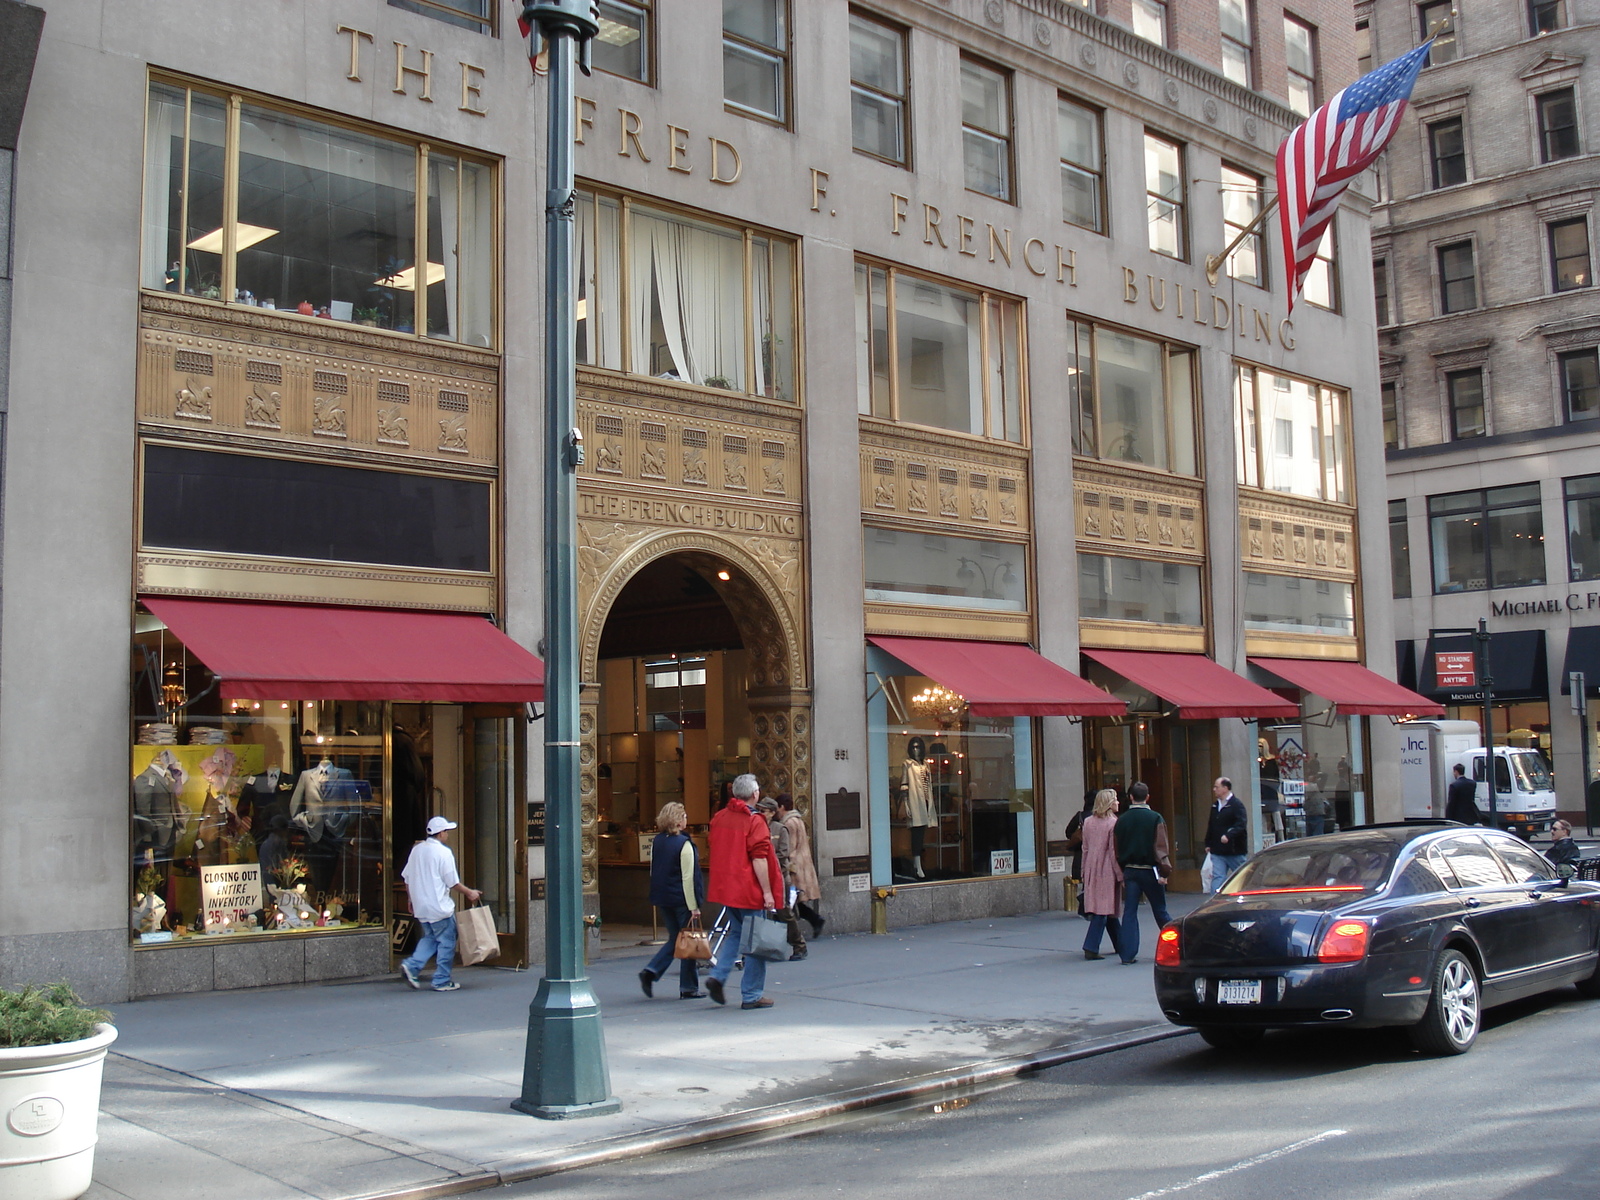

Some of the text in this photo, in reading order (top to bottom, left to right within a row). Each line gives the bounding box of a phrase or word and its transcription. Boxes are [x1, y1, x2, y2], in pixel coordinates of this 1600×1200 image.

[336, 22, 1297, 351] THE FRED F. FRENCH BUILDING
[579, 493, 796, 536] THE FRENCH BUILDING
[1491, 598, 1562, 617] MICHAEL
[1565, 593, 1583, 611] C.
[1447, 655, 1471, 663] STANDING
[1442, 676, 1468, 684] ANYTIME
[1407, 736, 1427, 751] Inc.
[1400, 757, 1422, 765] IANCE
[994, 857, 1012, 870] 20%
[204, 870, 258, 884] CLOSING OUT
[216, 883, 247, 896] ENTIRE
[208, 895, 258, 909] INVENTORY
[1223, 986, 1255, 999] 8131214
